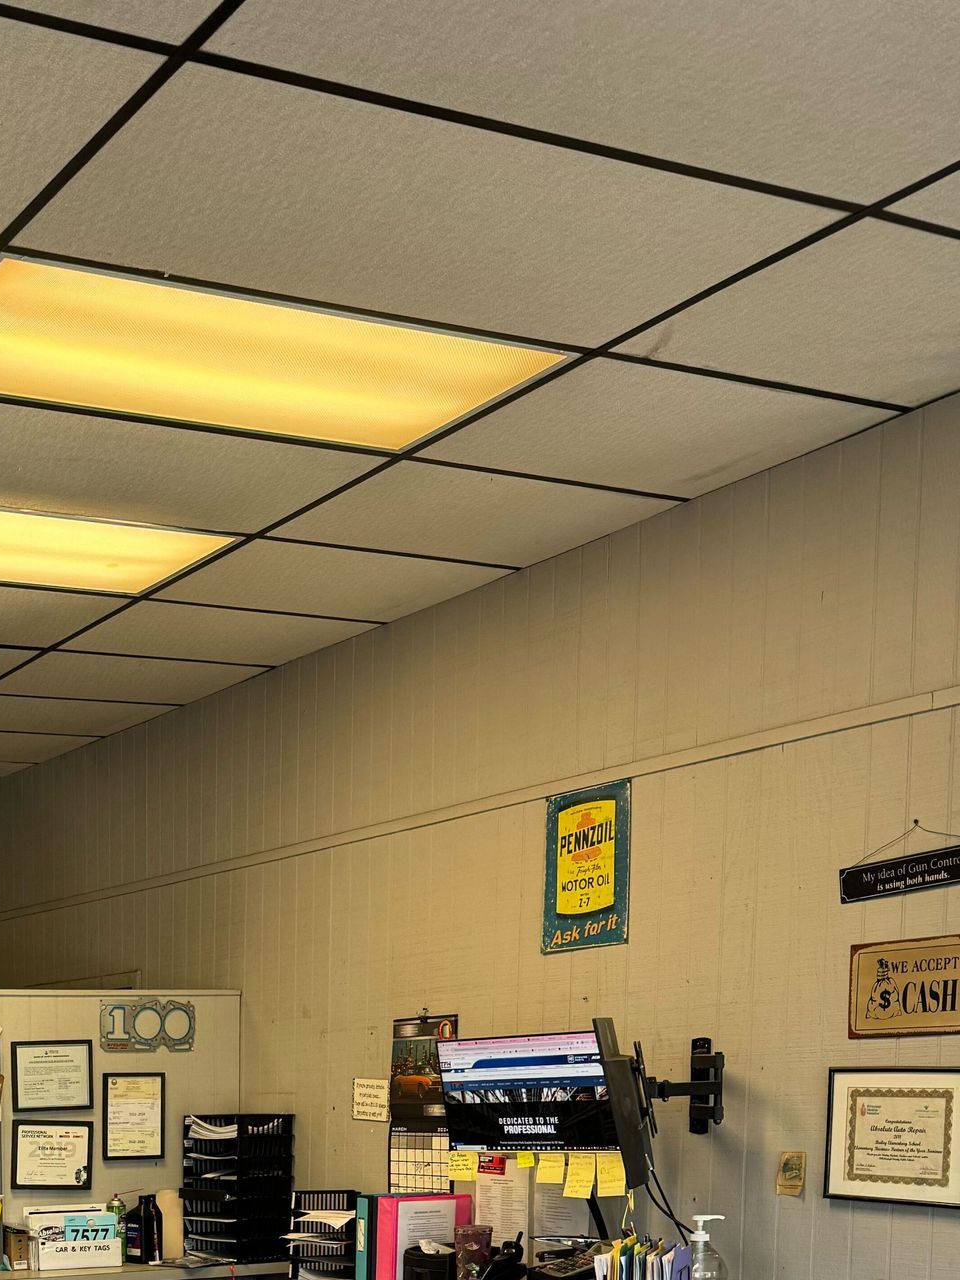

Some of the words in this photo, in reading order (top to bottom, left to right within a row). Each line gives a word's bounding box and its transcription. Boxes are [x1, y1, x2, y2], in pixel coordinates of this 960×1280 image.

[559, 820, 614, 857] PENNZOIL
[862, 872, 875, 884] My
[878, 868, 895, 879] idea
[897, 864, 906, 876] of
[908, 863, 928, 874] Gun
[930, 856, 960, 869] Contro
[561, 877, 594, 893] MOTOR
[596, 873, 610, 886] OIL
[877, 883, 883, 891] is
[885, 880, 905, 889] using
[906, 875, 922, 885] both
[925, 870, 950, 882] hands.
[551, 926, 580, 946] Ask
[584, 920, 605, 938] for
[607, 914, 618, 930] it
[891, 961, 908, 973] WE
[912, 957, 959, 972] ACCEPT
[902, 979, 958, 1014] CASH
[107, 1005, 191, 1040] 100
[504, 1124, 556, 1134] PROFESSIONAL
[546, 1116, 559, 1124] THE
[28, 1141, 76, 1158] 2019
[71, 1228, 109, 1241] 7577
